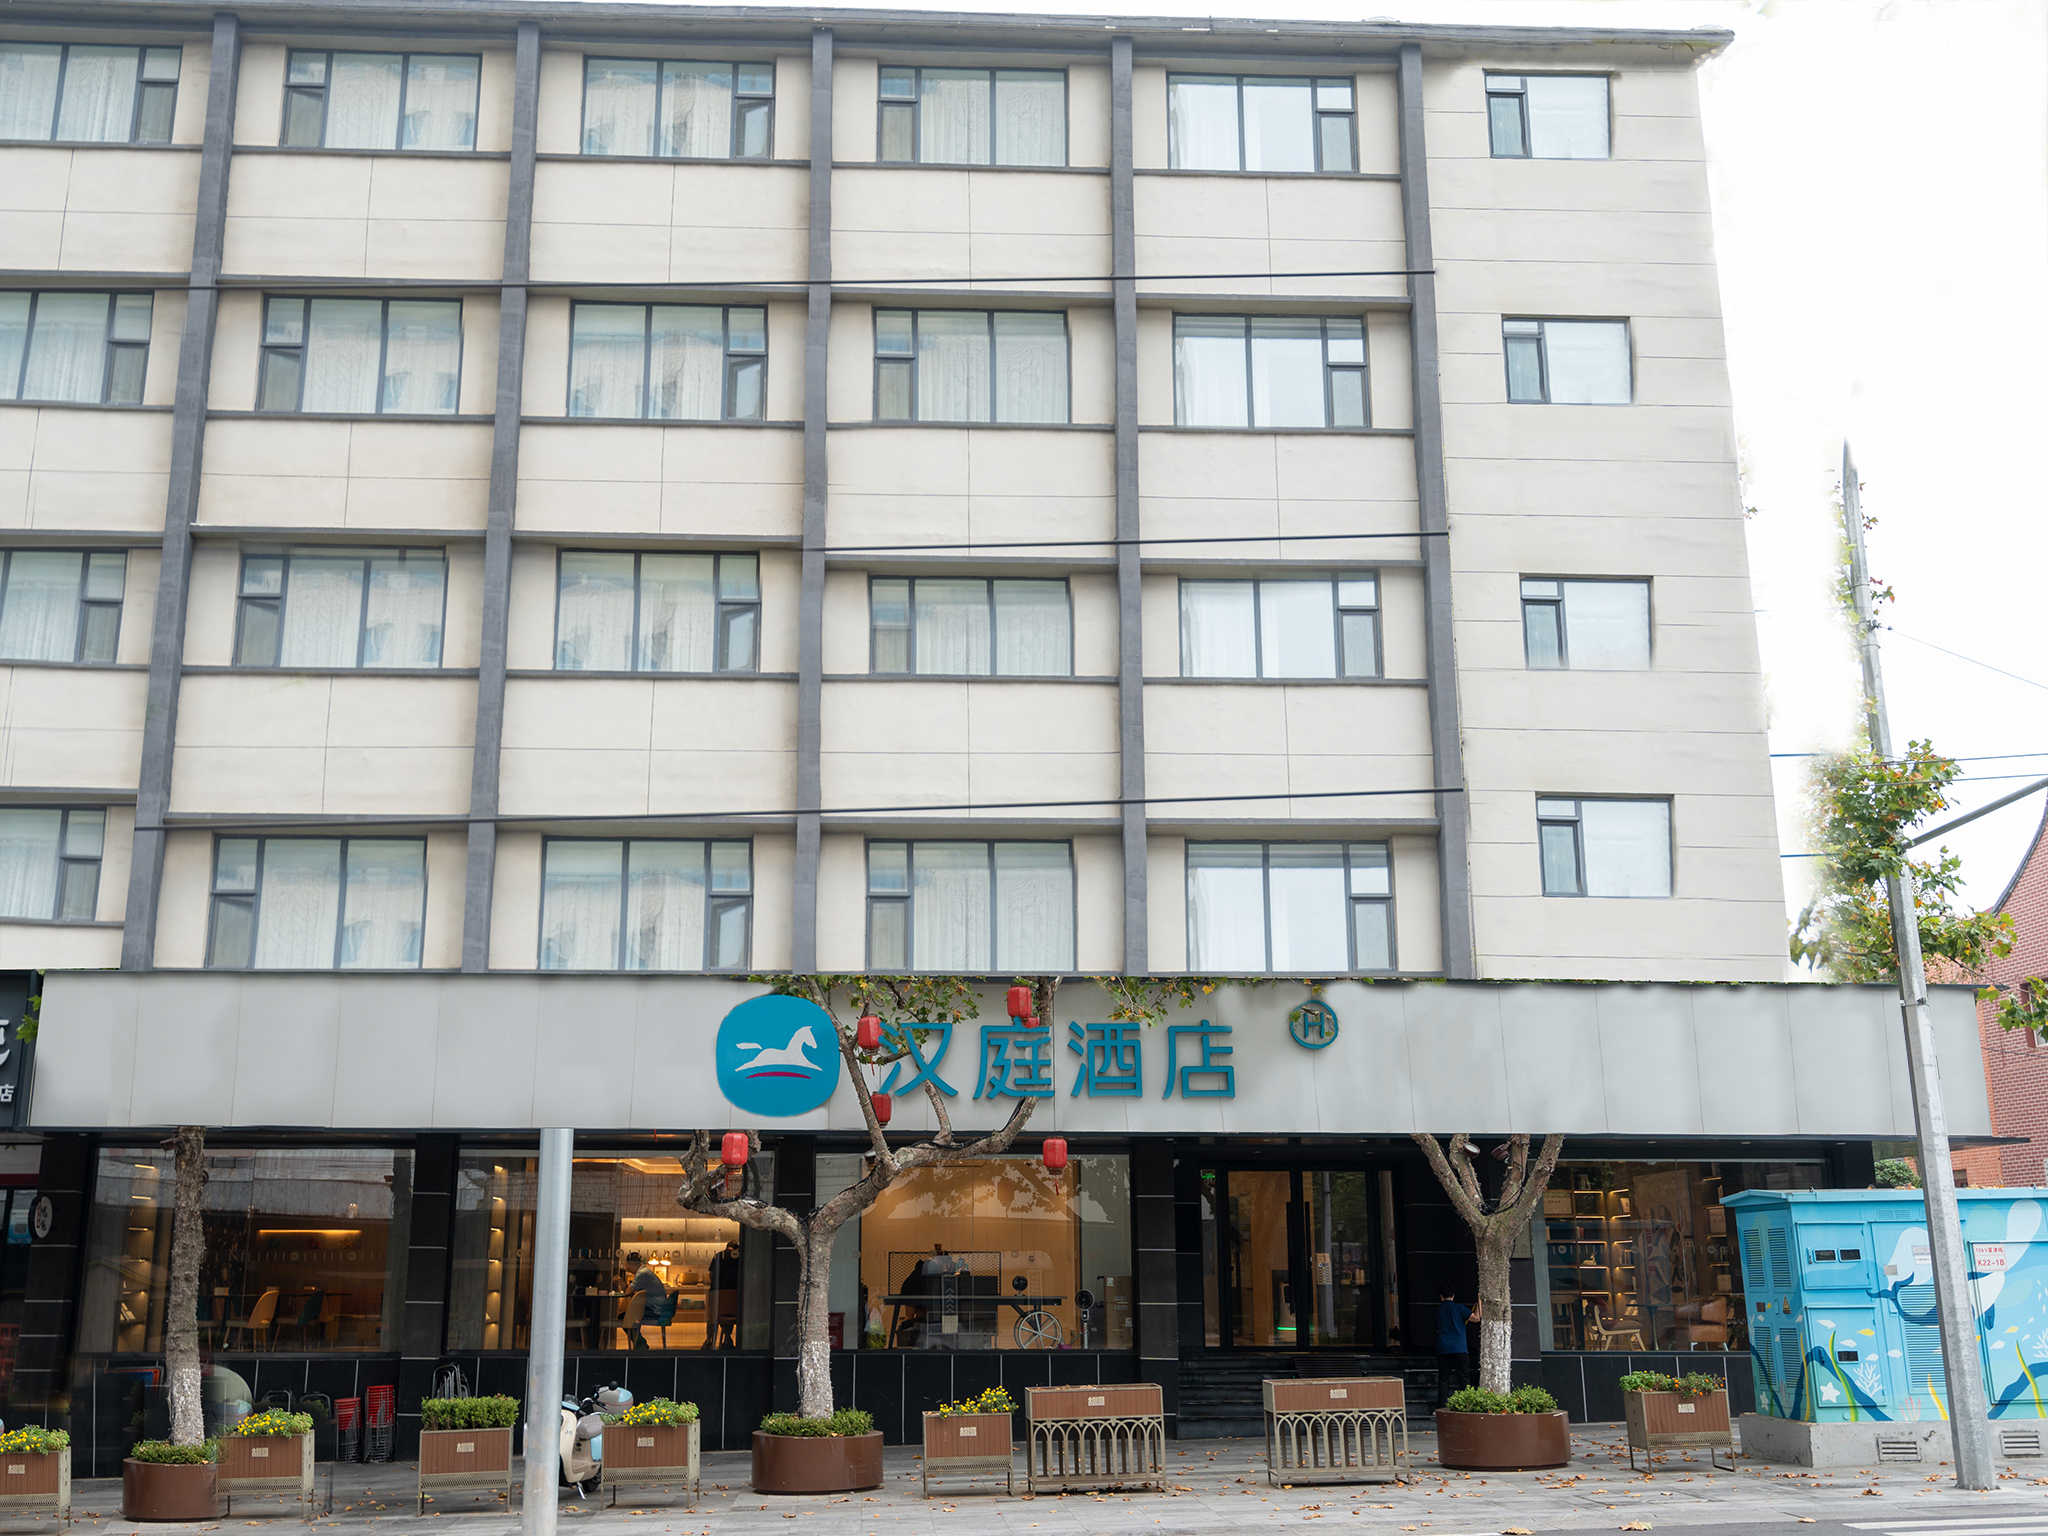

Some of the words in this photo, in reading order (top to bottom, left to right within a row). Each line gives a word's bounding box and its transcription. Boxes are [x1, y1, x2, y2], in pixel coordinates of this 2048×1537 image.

[879, 1016, 1236, 1100] 汉庭酒店
[1977, 1258, 2005, 1267] K22-1B
